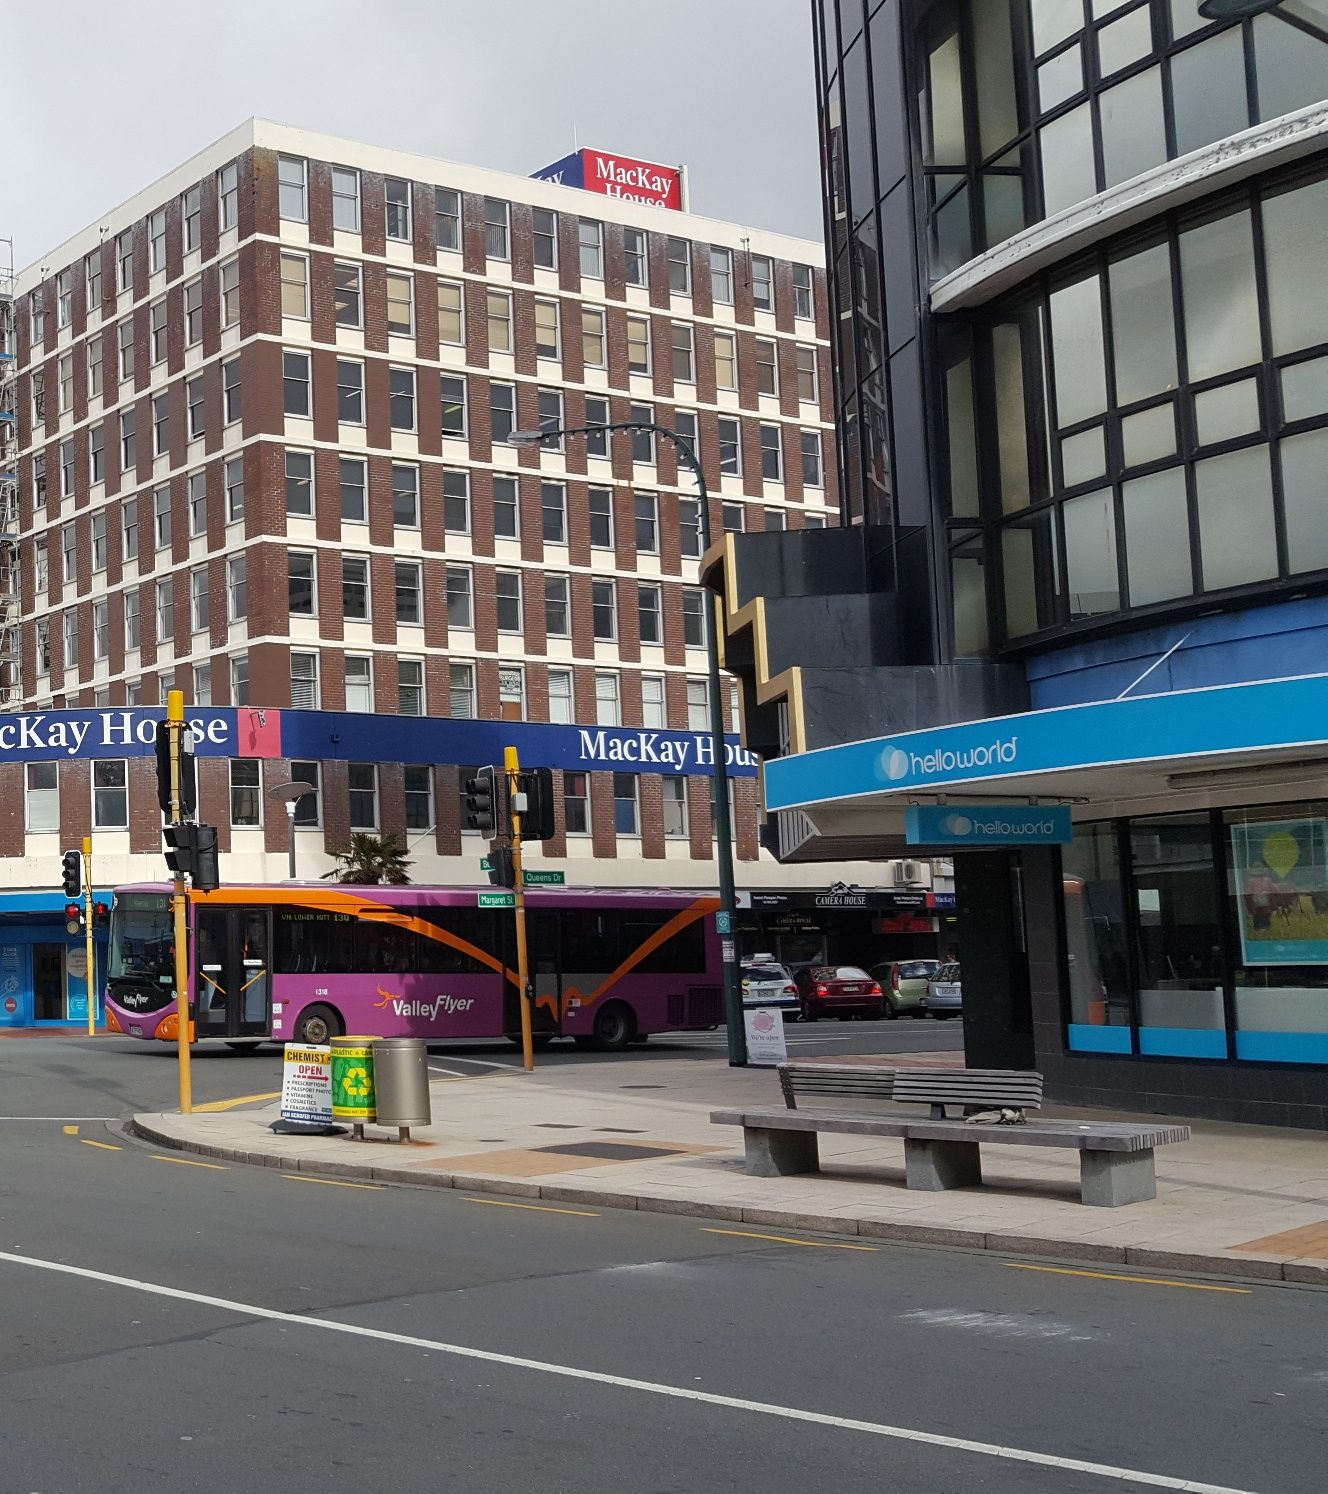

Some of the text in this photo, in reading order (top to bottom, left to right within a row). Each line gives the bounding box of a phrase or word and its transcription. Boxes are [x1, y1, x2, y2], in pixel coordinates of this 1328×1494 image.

[595, 157, 672, 199] MacKay
[99, 712, 229, 746] Hose
[578, 730, 690, 771] MacKay
[909, 737, 1017, 776] helloworld
[974, 819, 1054, 835] helloworld
[526, 873, 562, 882] Queens Dr
[480, 896, 506, 905] Margaret
[815, 896, 866, 905] CAMERA HOUSE
[287, 1052, 325, 1063] CHEMIST
[299, 1065, 322, 1075] OPEN
